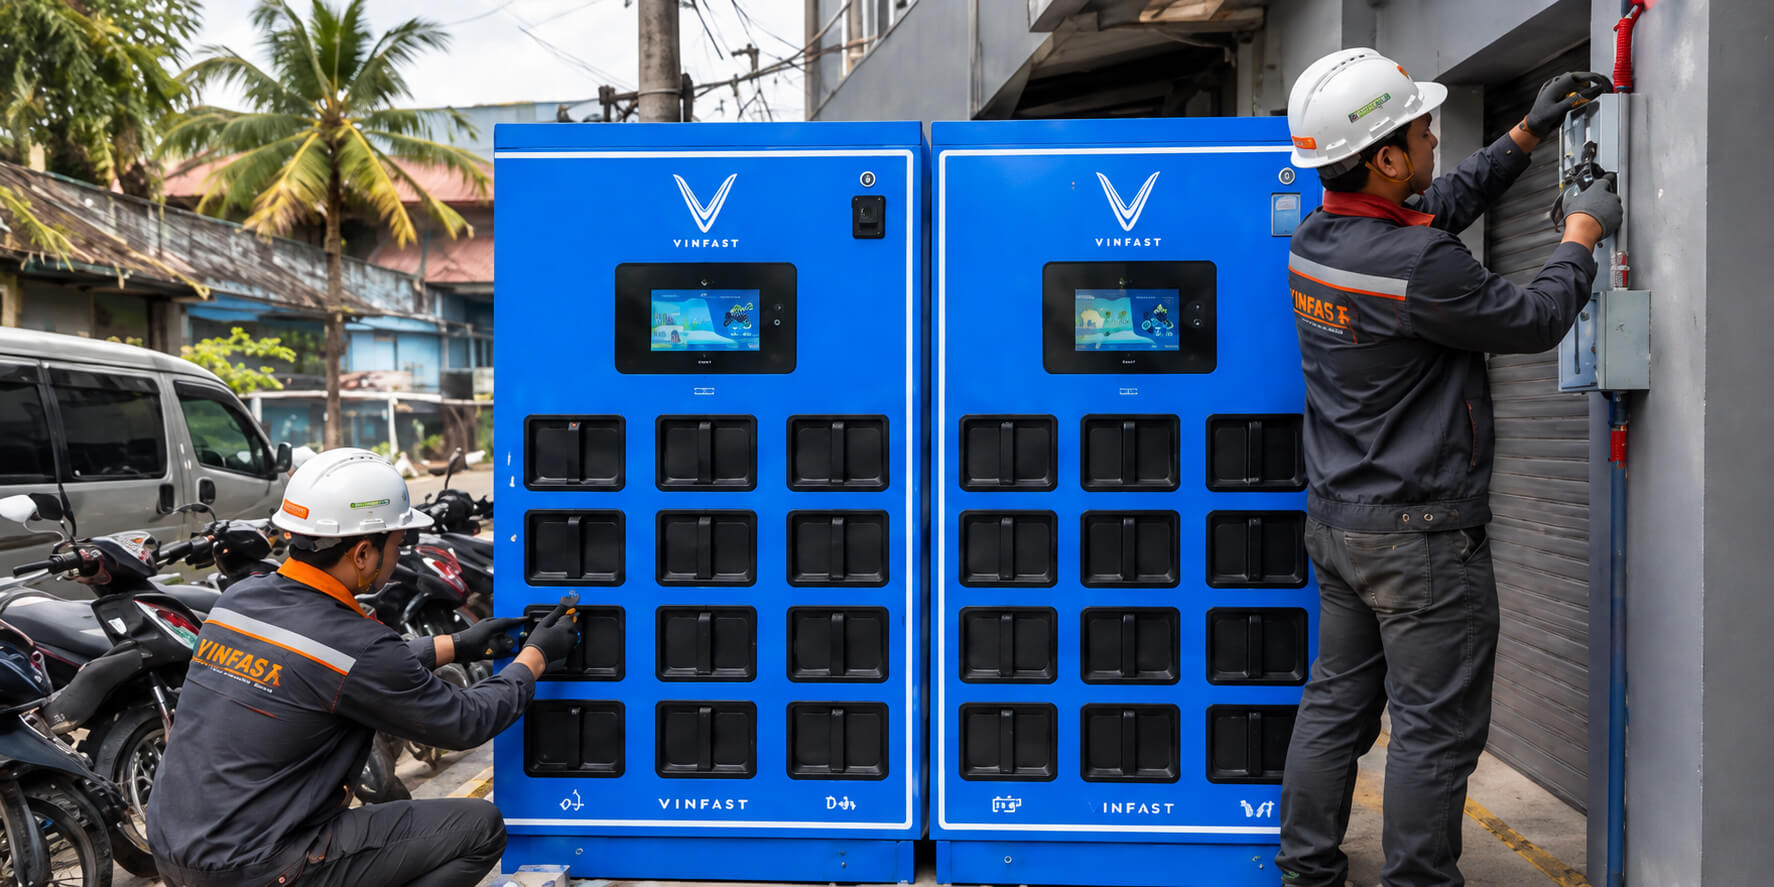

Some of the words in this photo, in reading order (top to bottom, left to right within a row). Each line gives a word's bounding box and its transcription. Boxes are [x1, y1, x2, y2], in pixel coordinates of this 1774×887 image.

[673, 239, 739, 248] VINFAST
[1095, 237, 1162, 247] VINFAST
[658, 798, 749, 810] VINFAST
